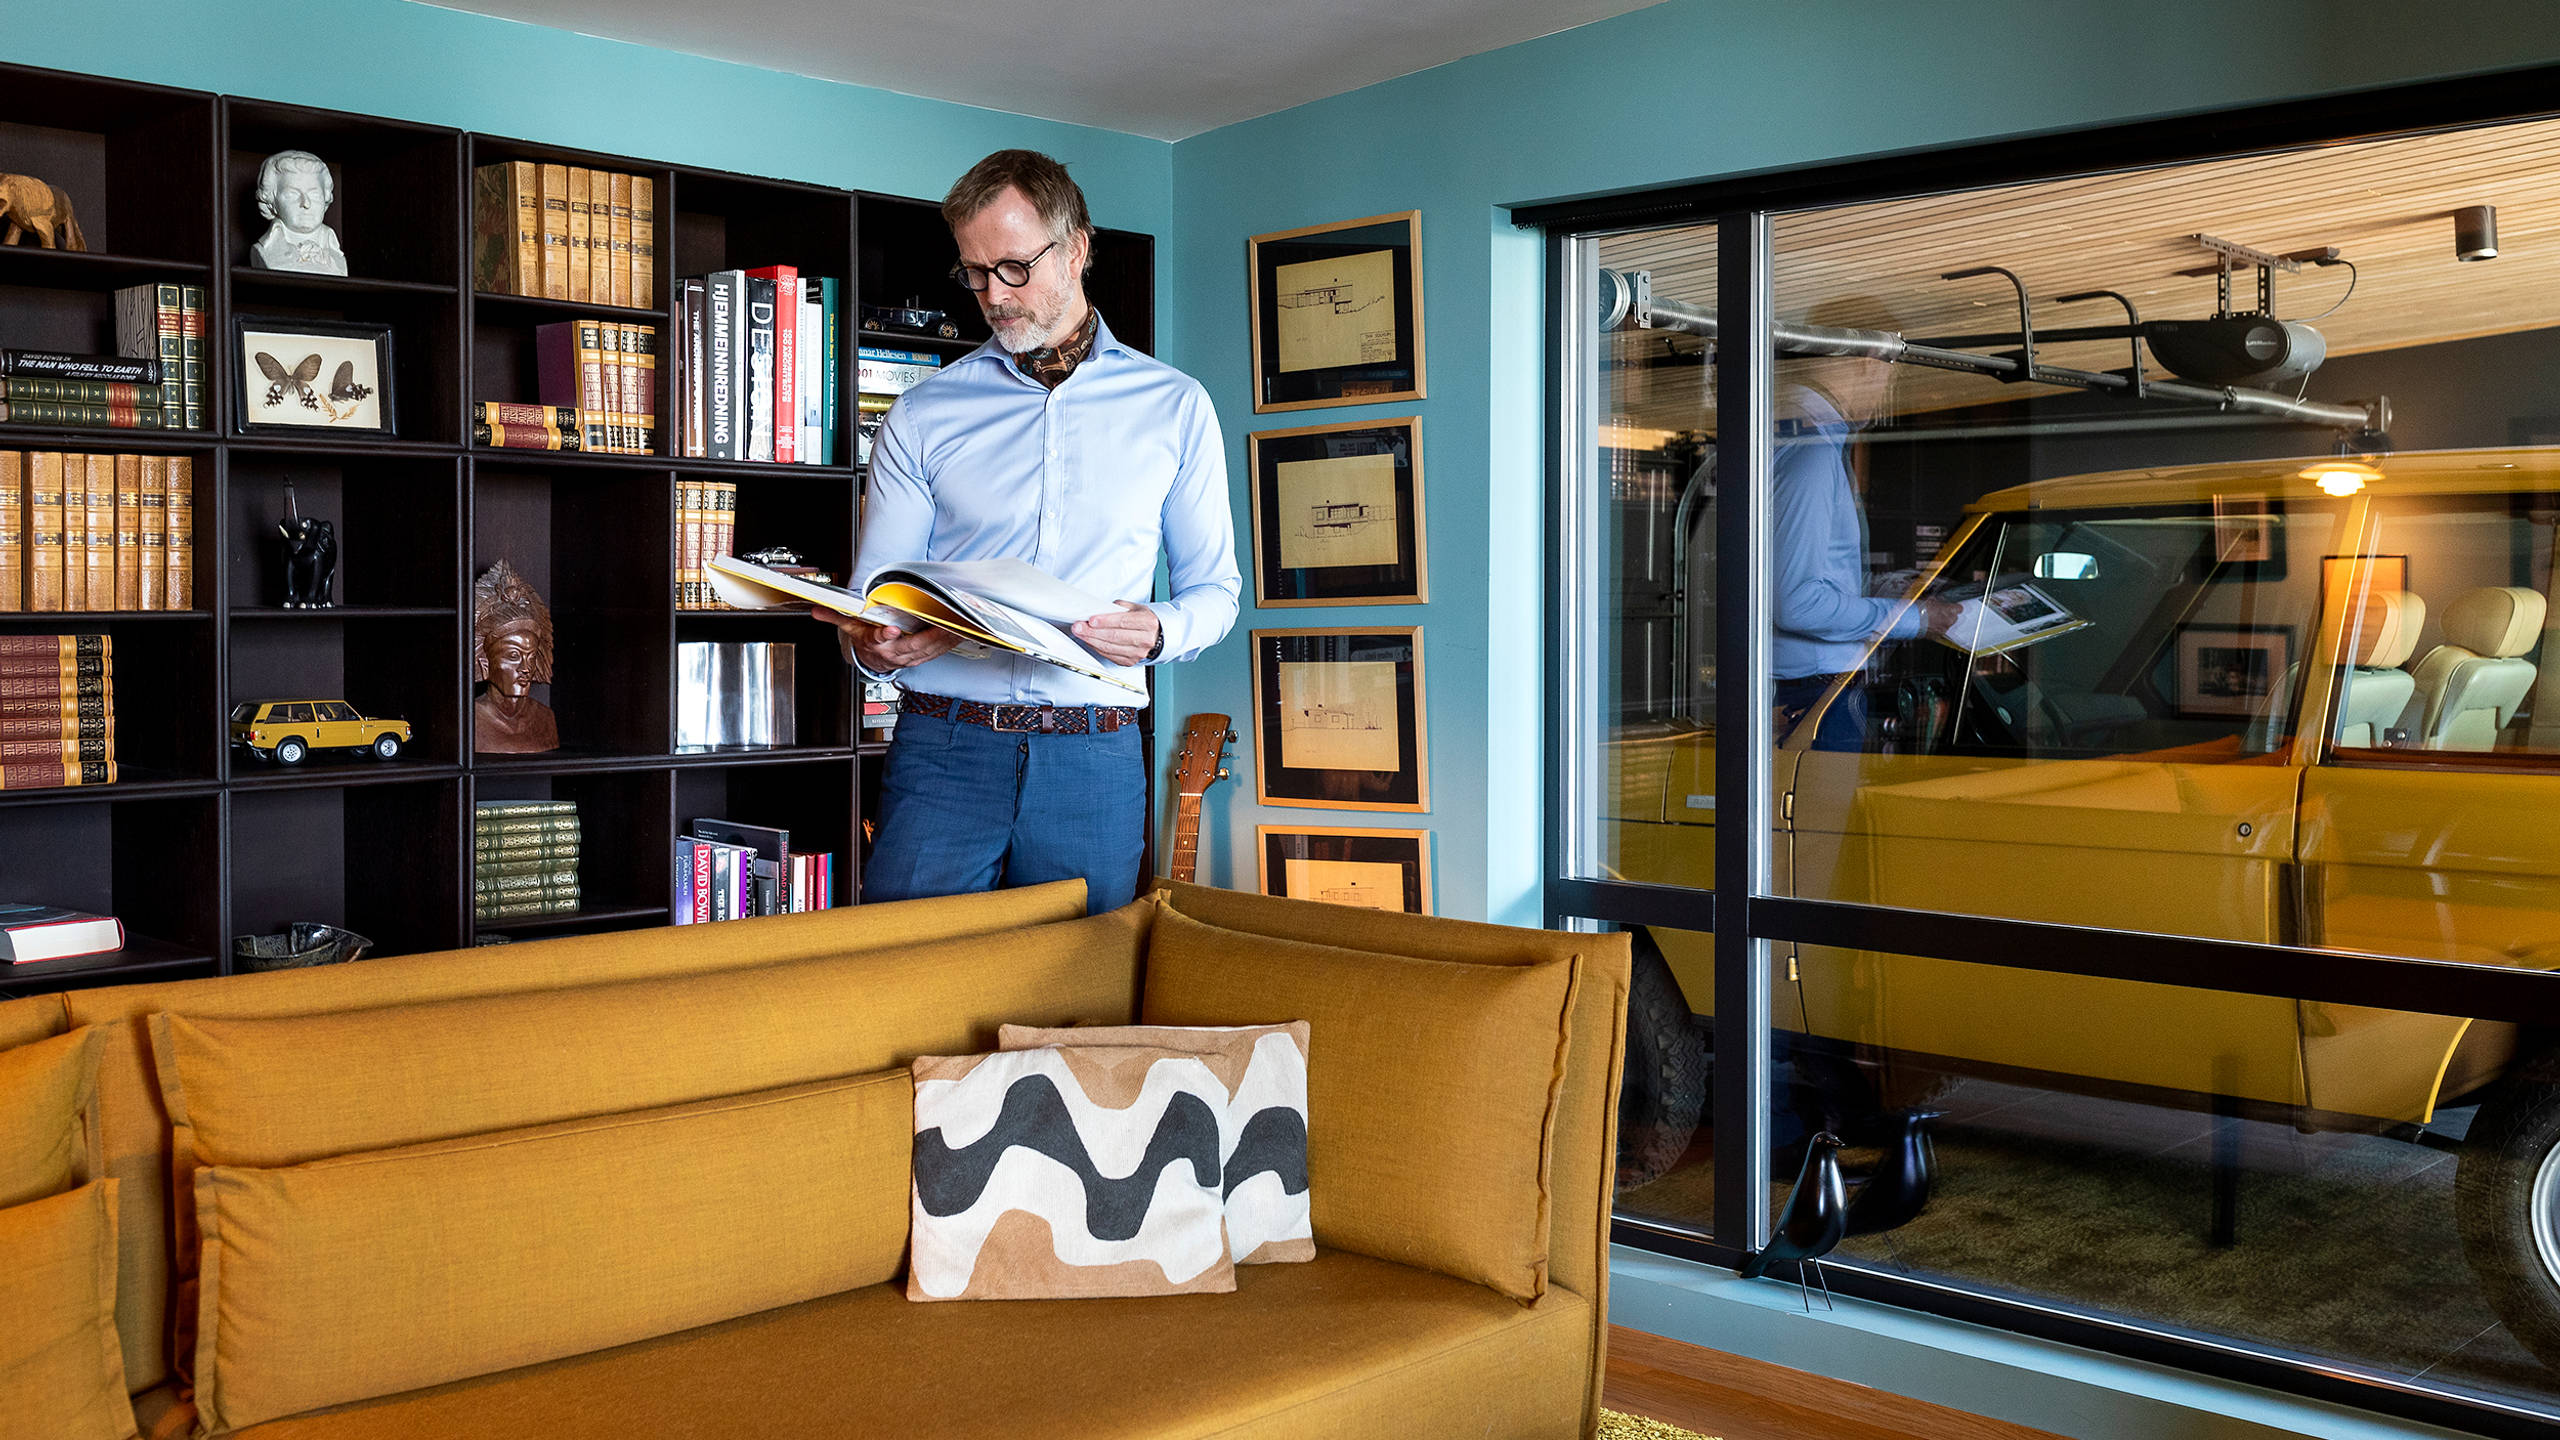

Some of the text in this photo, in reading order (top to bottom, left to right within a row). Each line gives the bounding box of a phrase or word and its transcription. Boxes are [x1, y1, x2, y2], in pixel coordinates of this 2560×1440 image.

[18, 359, 36, 368] THE
[36, 360, 58, 370] MAN
[57, 362, 81, 371] WHO
[79, 363, 100, 372] FELL
[101, 364, 115, 373] TO
[114, 366, 144, 375] EARTH
[713, 283, 730, 445] HJEMMEINNREDNING
[874, 370, 916, 384] MOVIES
[697, 849, 709, 887] DAVID
[717, 888, 725, 908] THE
